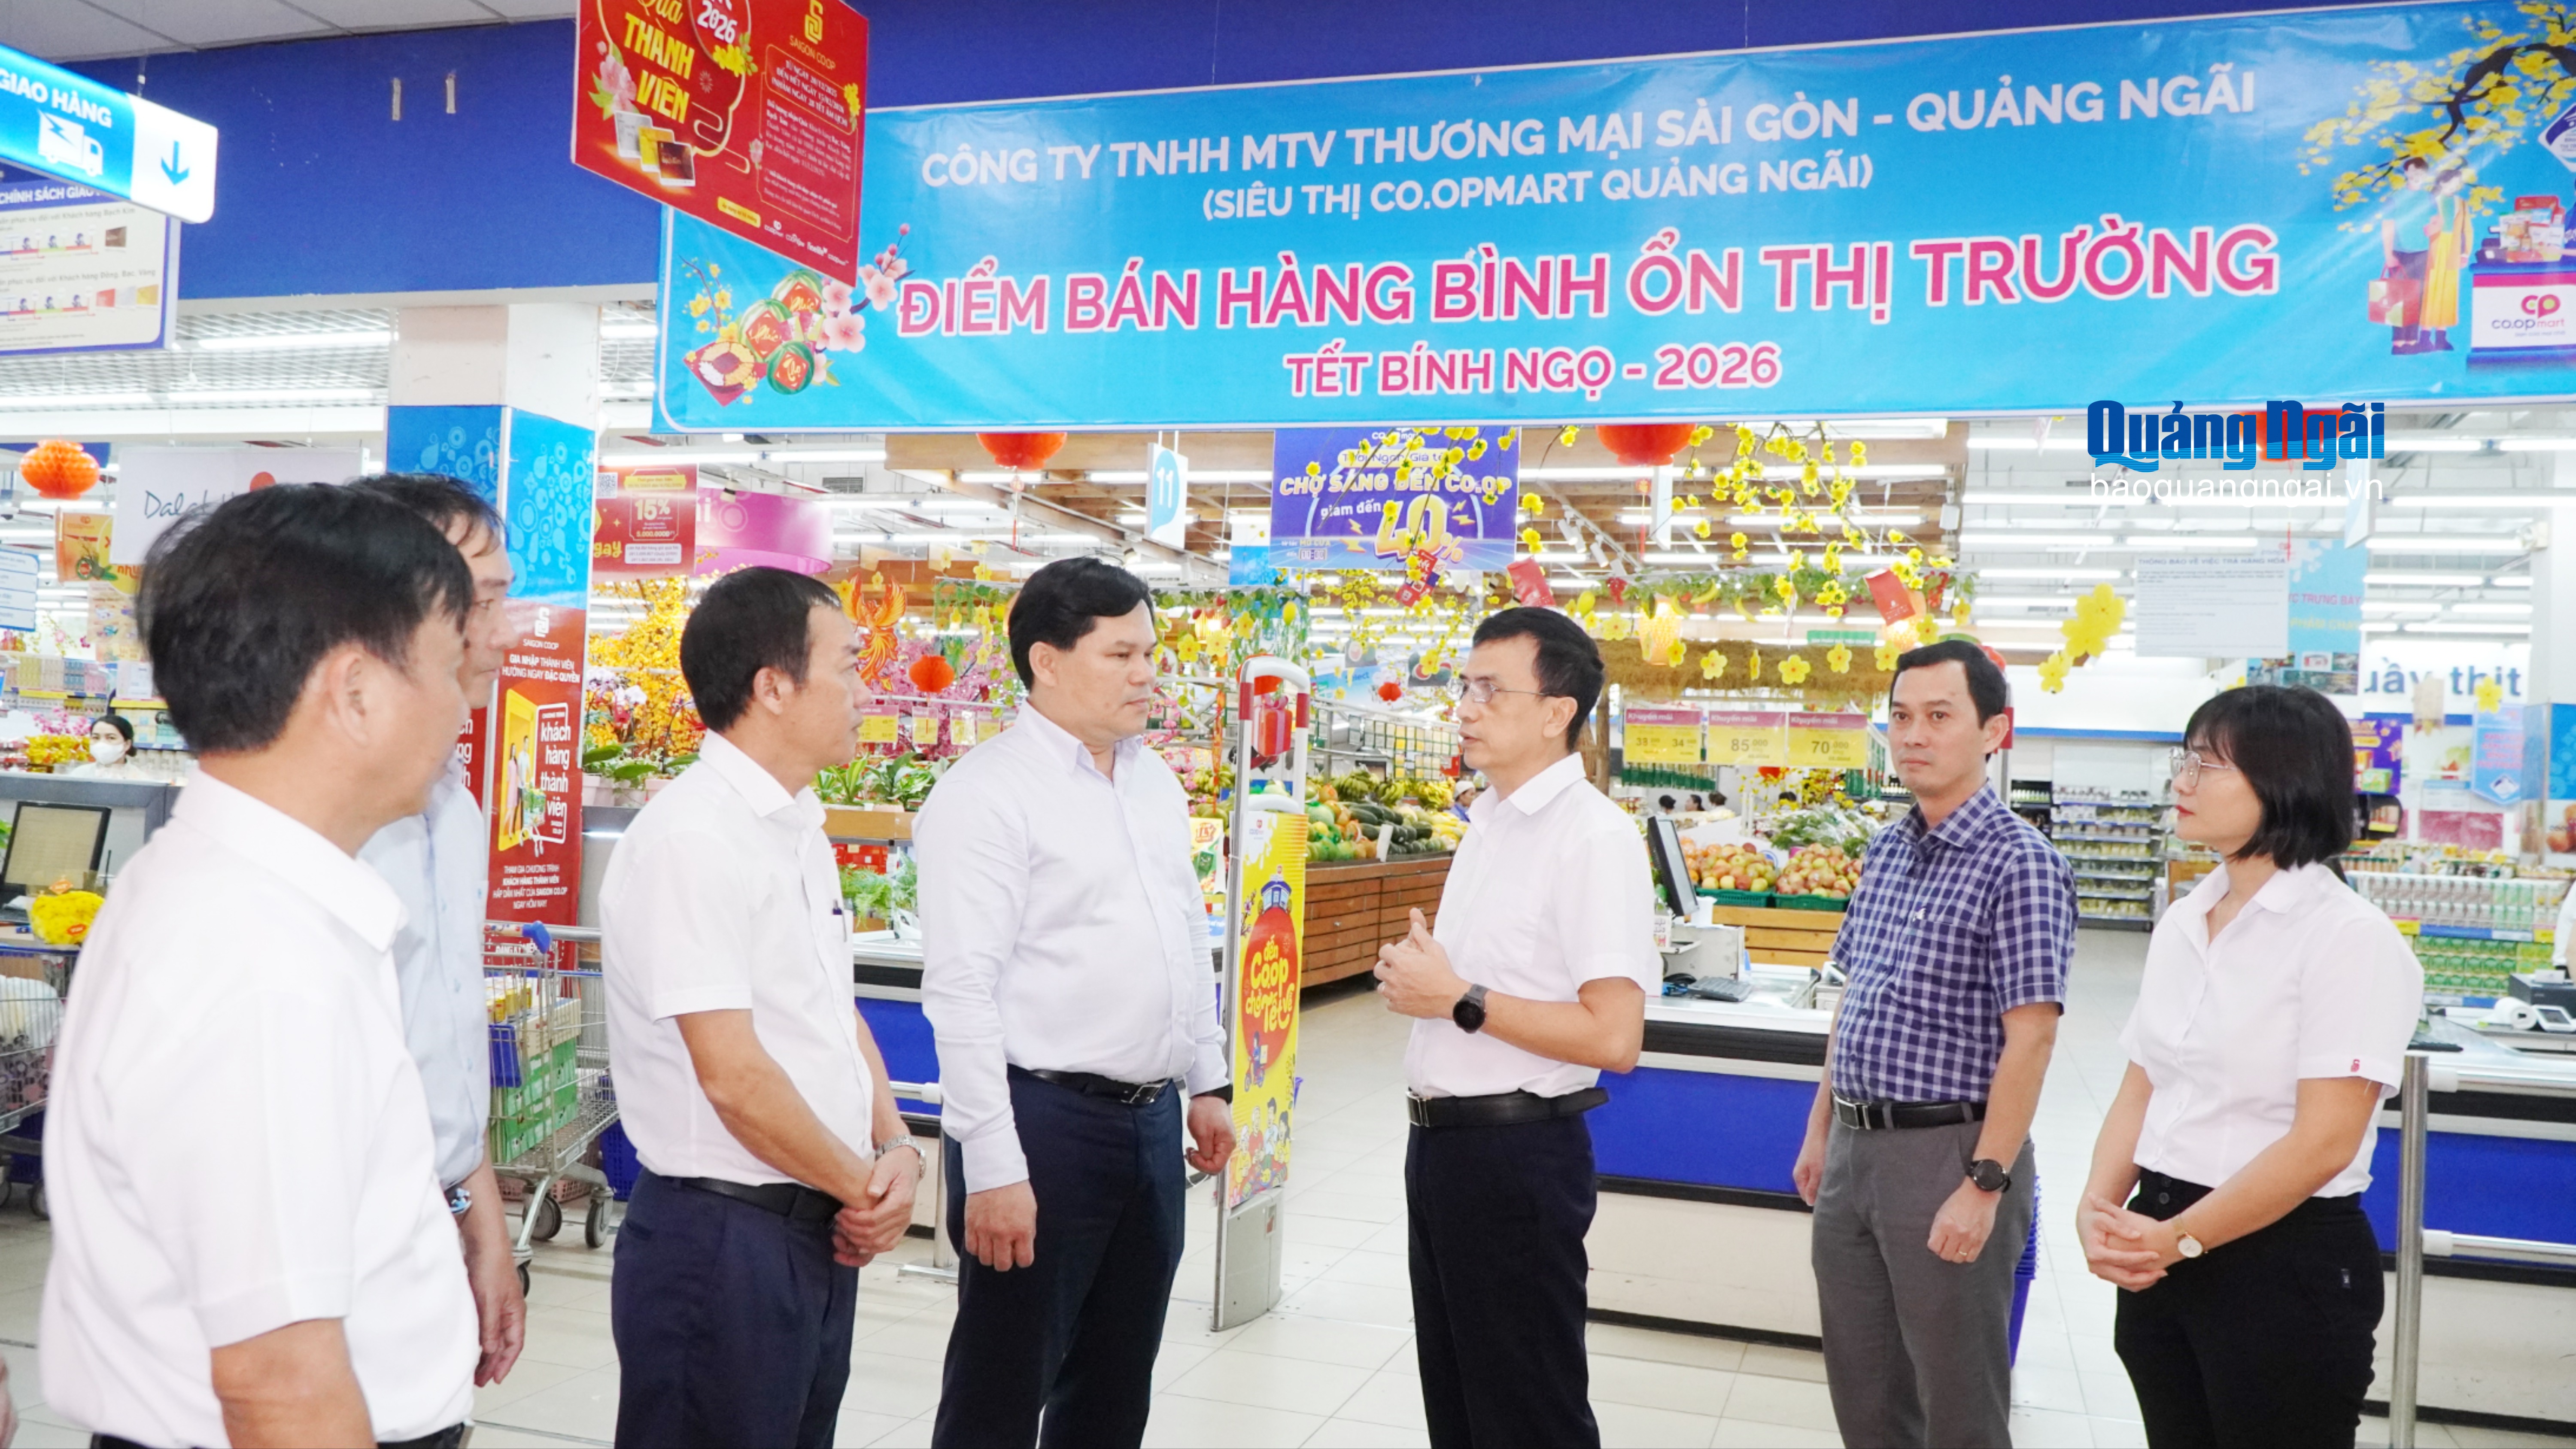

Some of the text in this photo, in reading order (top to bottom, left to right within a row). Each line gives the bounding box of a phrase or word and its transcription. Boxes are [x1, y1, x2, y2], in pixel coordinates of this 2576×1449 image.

[697, 0, 738, 43] 2026
[624, 11, 695, 80] THÀNH
[790, 35, 815, 59] SAIGON
[52, 88, 112, 128] HÀNG
[636, 69, 690, 124] VIÊN
[922, 62, 2254, 187] CÔNG TY TNHH MTV THƯƠNG MẠI SÀI GÒN - QUẢNG NGÃI
[34, 186, 64, 202] SÁCH
[1203, 149, 1873, 221] (SIÊU THỊ CO.OPMART QUẢNG NGÃI)
[898, 213, 2279, 336] ĐIỂM BÁN HÀNG BÌNH ỔN THỊ TRƯỜNG
[1283, 337, 1782, 401] TẾT BÍNH NGỌ - 2026
[1157, 467, 1175, 509] 11
[1328, 468, 1388, 492] SÁNG
[635, 499, 671, 520] 15%
[1356, 498, 1381, 515] đến
[594, 541, 622, 558] gay
[510, 654, 520, 663] GIA
[541, 721, 571, 741] khách
[545, 745, 570, 770] hàng
[541, 772, 568, 793] thành
[547, 796, 567, 817] viên
[1264, 934, 1278, 962] đến
